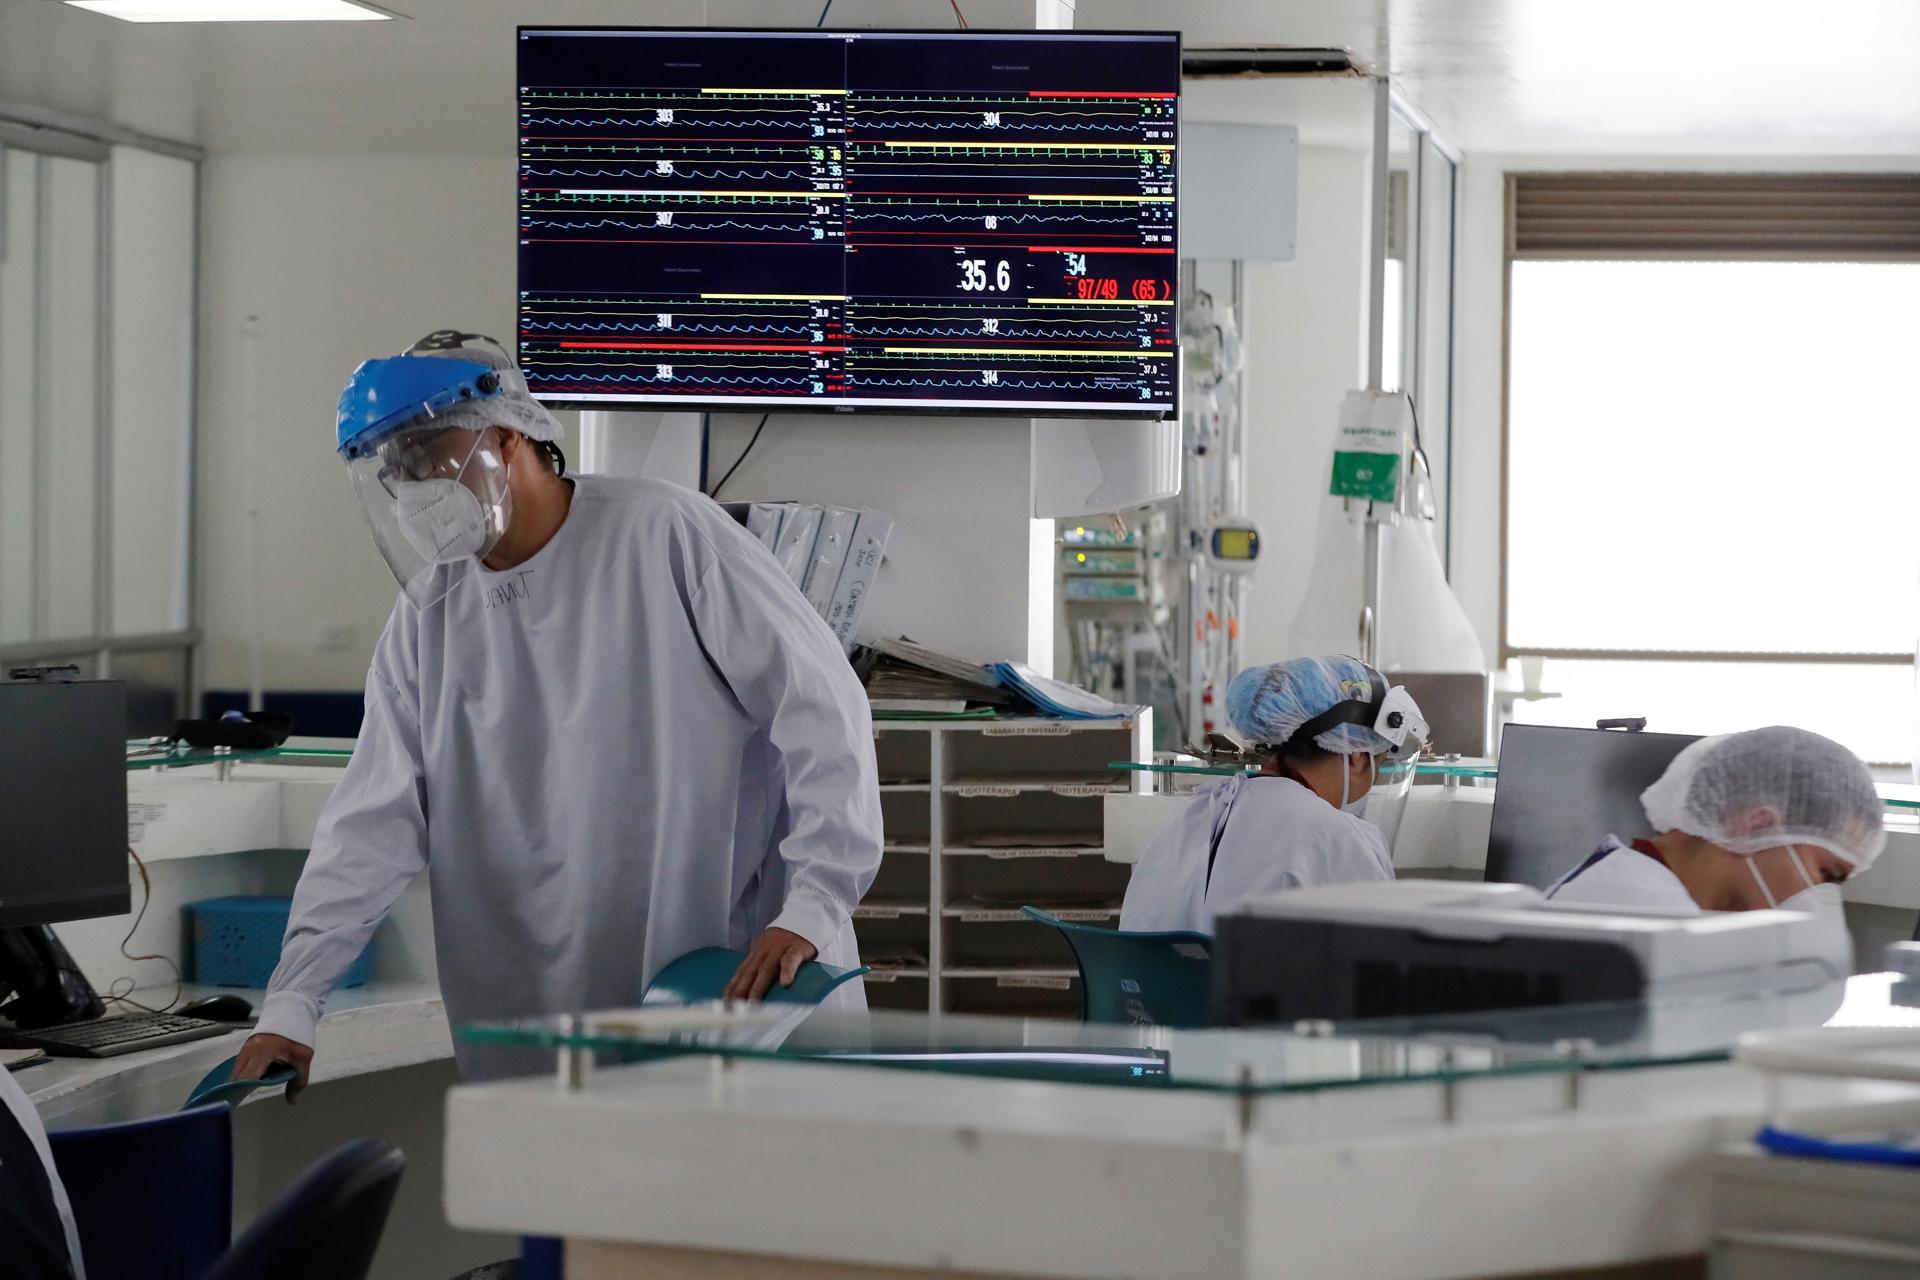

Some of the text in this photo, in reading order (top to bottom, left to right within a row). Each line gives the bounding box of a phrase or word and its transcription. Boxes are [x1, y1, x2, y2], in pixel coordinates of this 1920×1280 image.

[656, 109, 673, 122] 303
[983, 112, 1000, 126] 304
[656, 160, 673, 174] 305
[656, 211, 673, 225] 307
[1067, 253, 1087, 276] 54
[961, 259, 1011, 292] 35.6
[1077, 278, 1118, 300] 97/49
[982, 318, 999, 333] 312
[982, 369, 998, 384] 314
[960, 786, 1017, 795] FISIOTERAPIA
